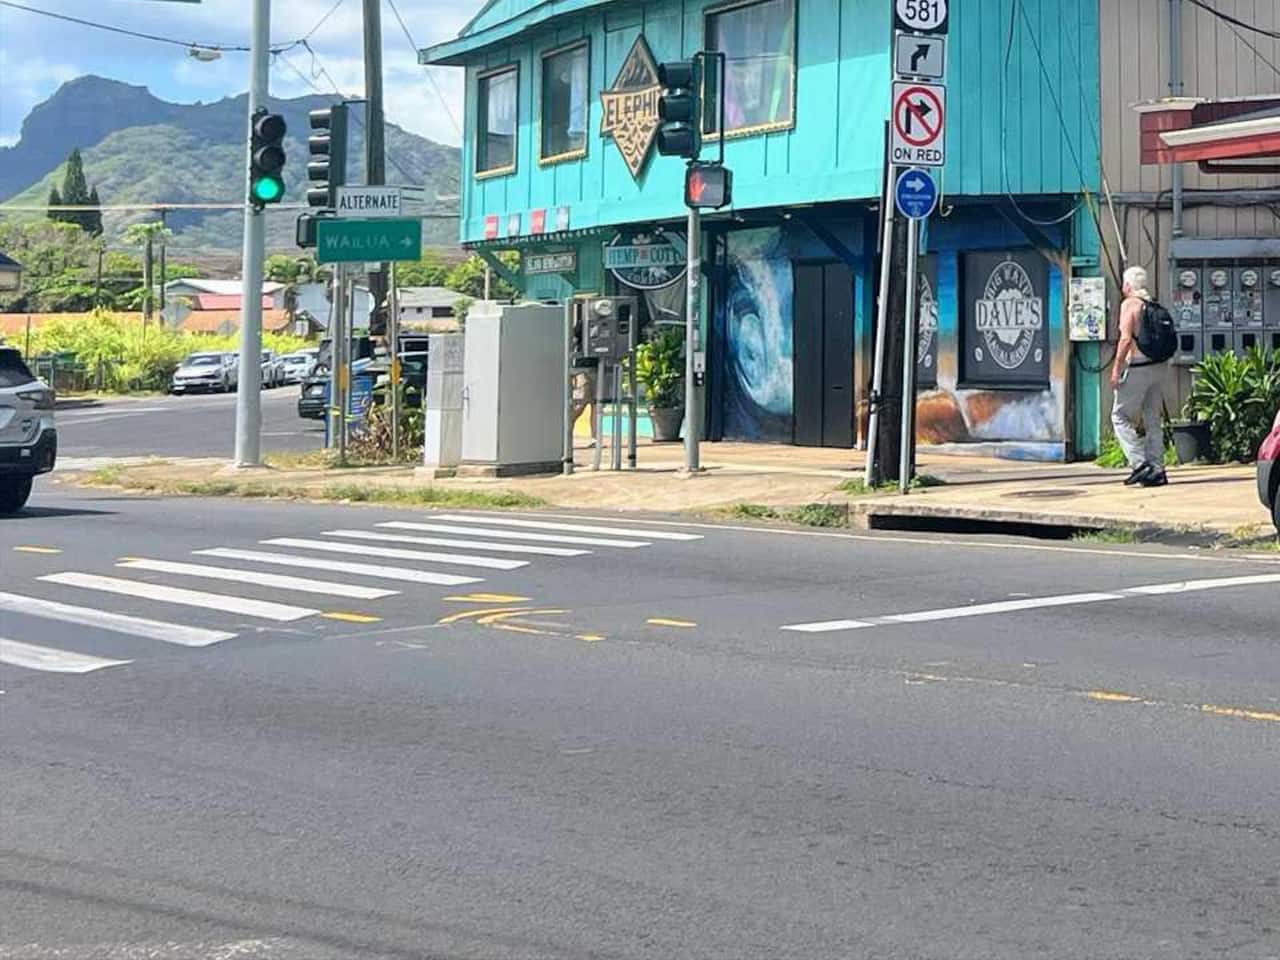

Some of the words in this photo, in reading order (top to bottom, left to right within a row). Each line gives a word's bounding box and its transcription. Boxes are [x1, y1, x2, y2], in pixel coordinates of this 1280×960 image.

[894, 147, 911, 160] ON
[916, 149, 942, 161] RED
[340, 194, 398, 209] ALTERNATE
[978, 300, 1041, 327] DAVE'S
